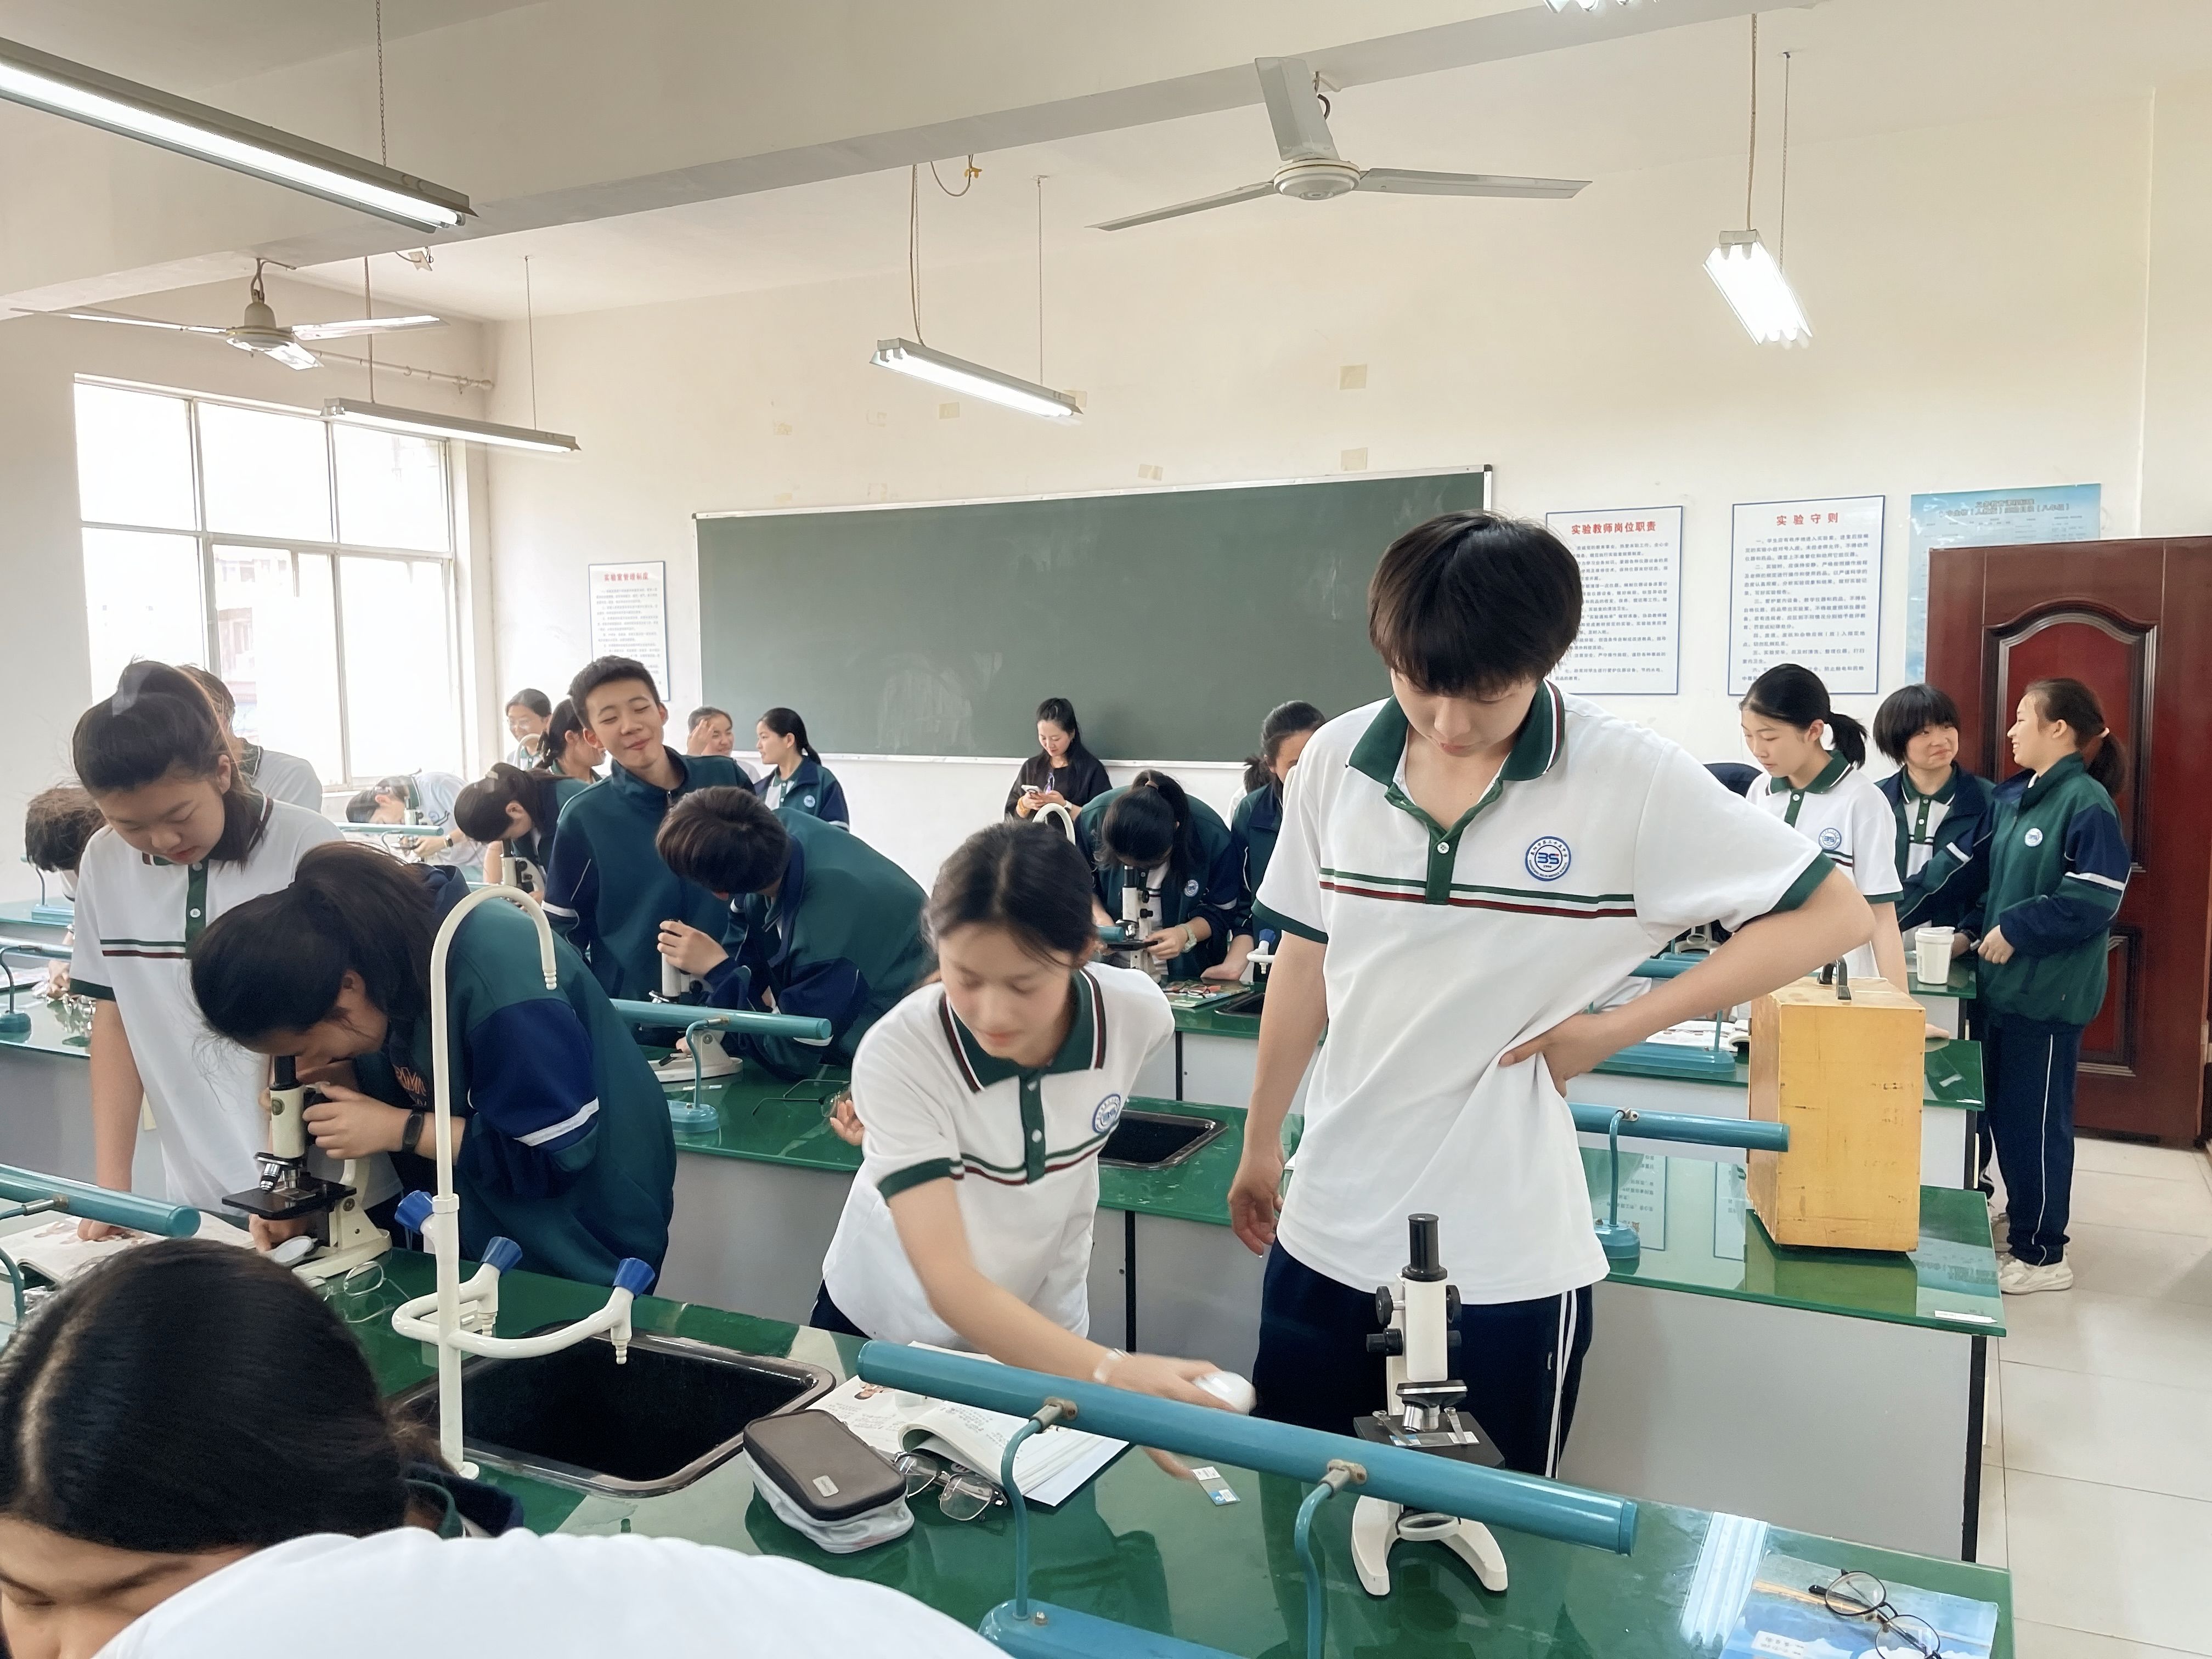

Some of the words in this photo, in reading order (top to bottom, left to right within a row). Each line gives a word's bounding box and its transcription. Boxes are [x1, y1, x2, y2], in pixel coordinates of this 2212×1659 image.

[1776, 512, 1838, 526] 实验守则
[1572, 521, 1656, 534] 实验教师岗位职责
[604, 572, 649, 582] 实验室管理制度
